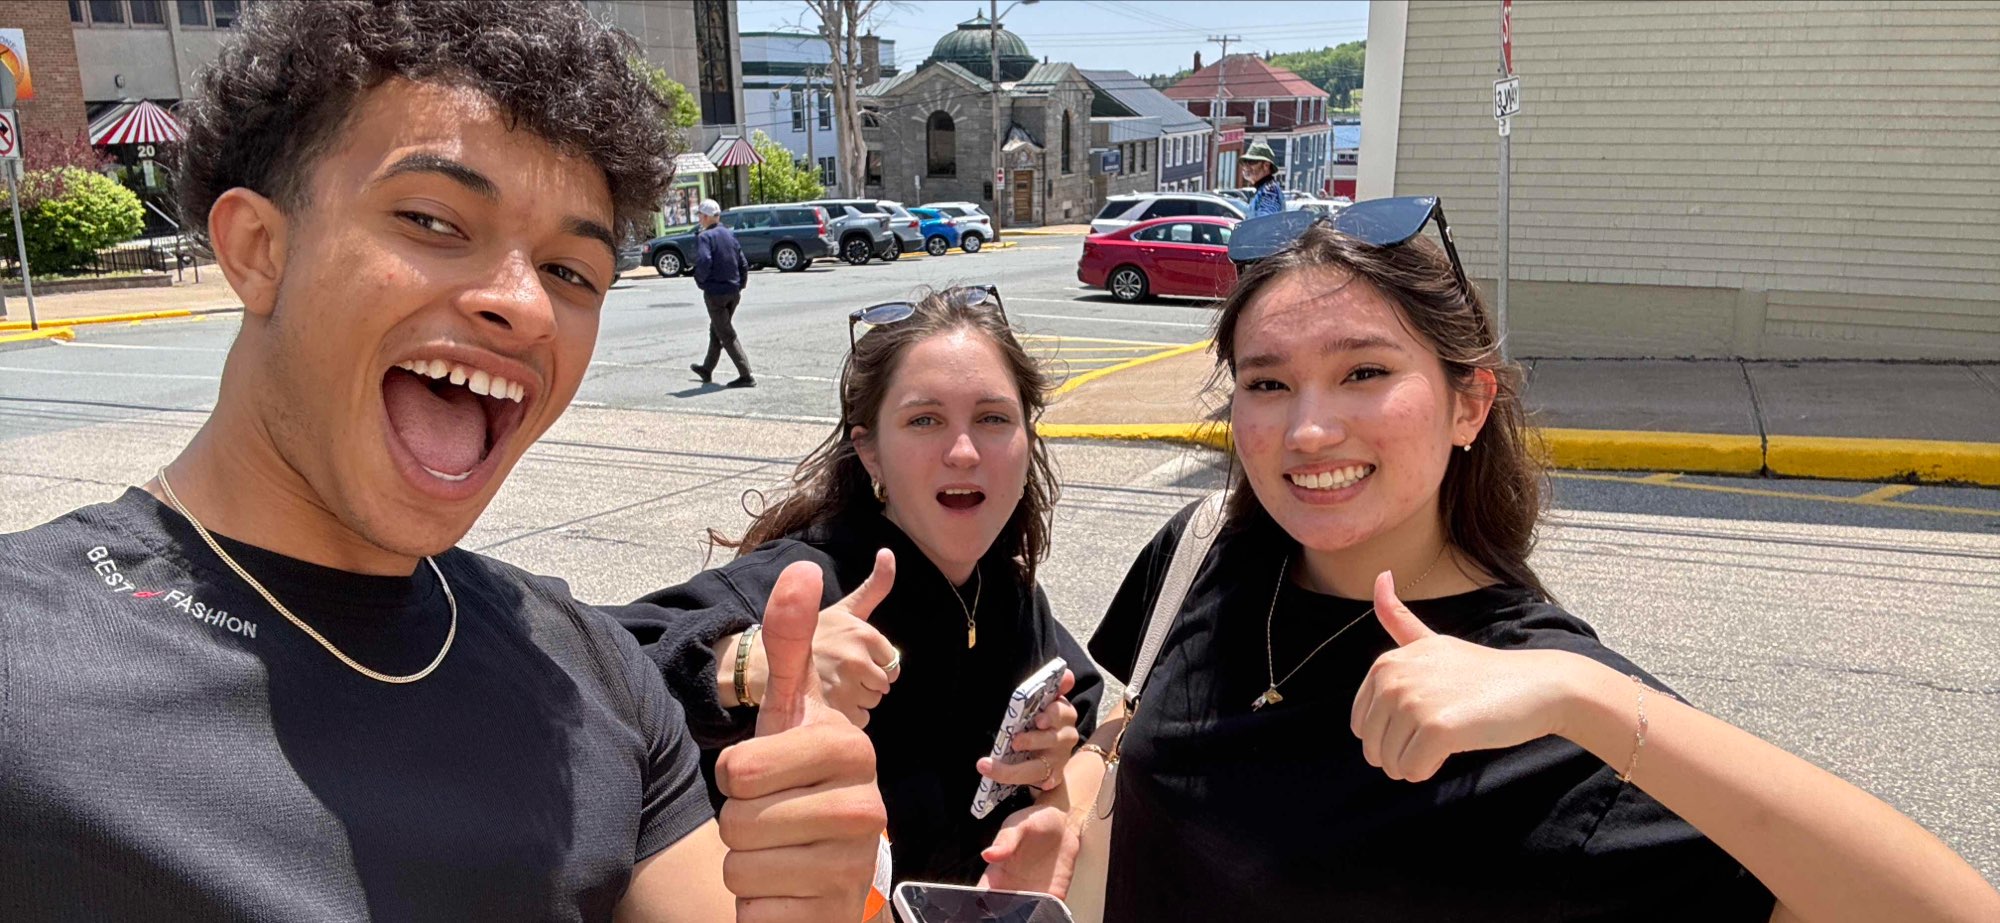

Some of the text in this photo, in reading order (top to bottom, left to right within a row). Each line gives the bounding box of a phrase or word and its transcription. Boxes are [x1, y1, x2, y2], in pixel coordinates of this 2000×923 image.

[137, 144, 155, 158] 20
[86, 545, 135, 593] BEST
[163, 589, 257, 639] FASHION
